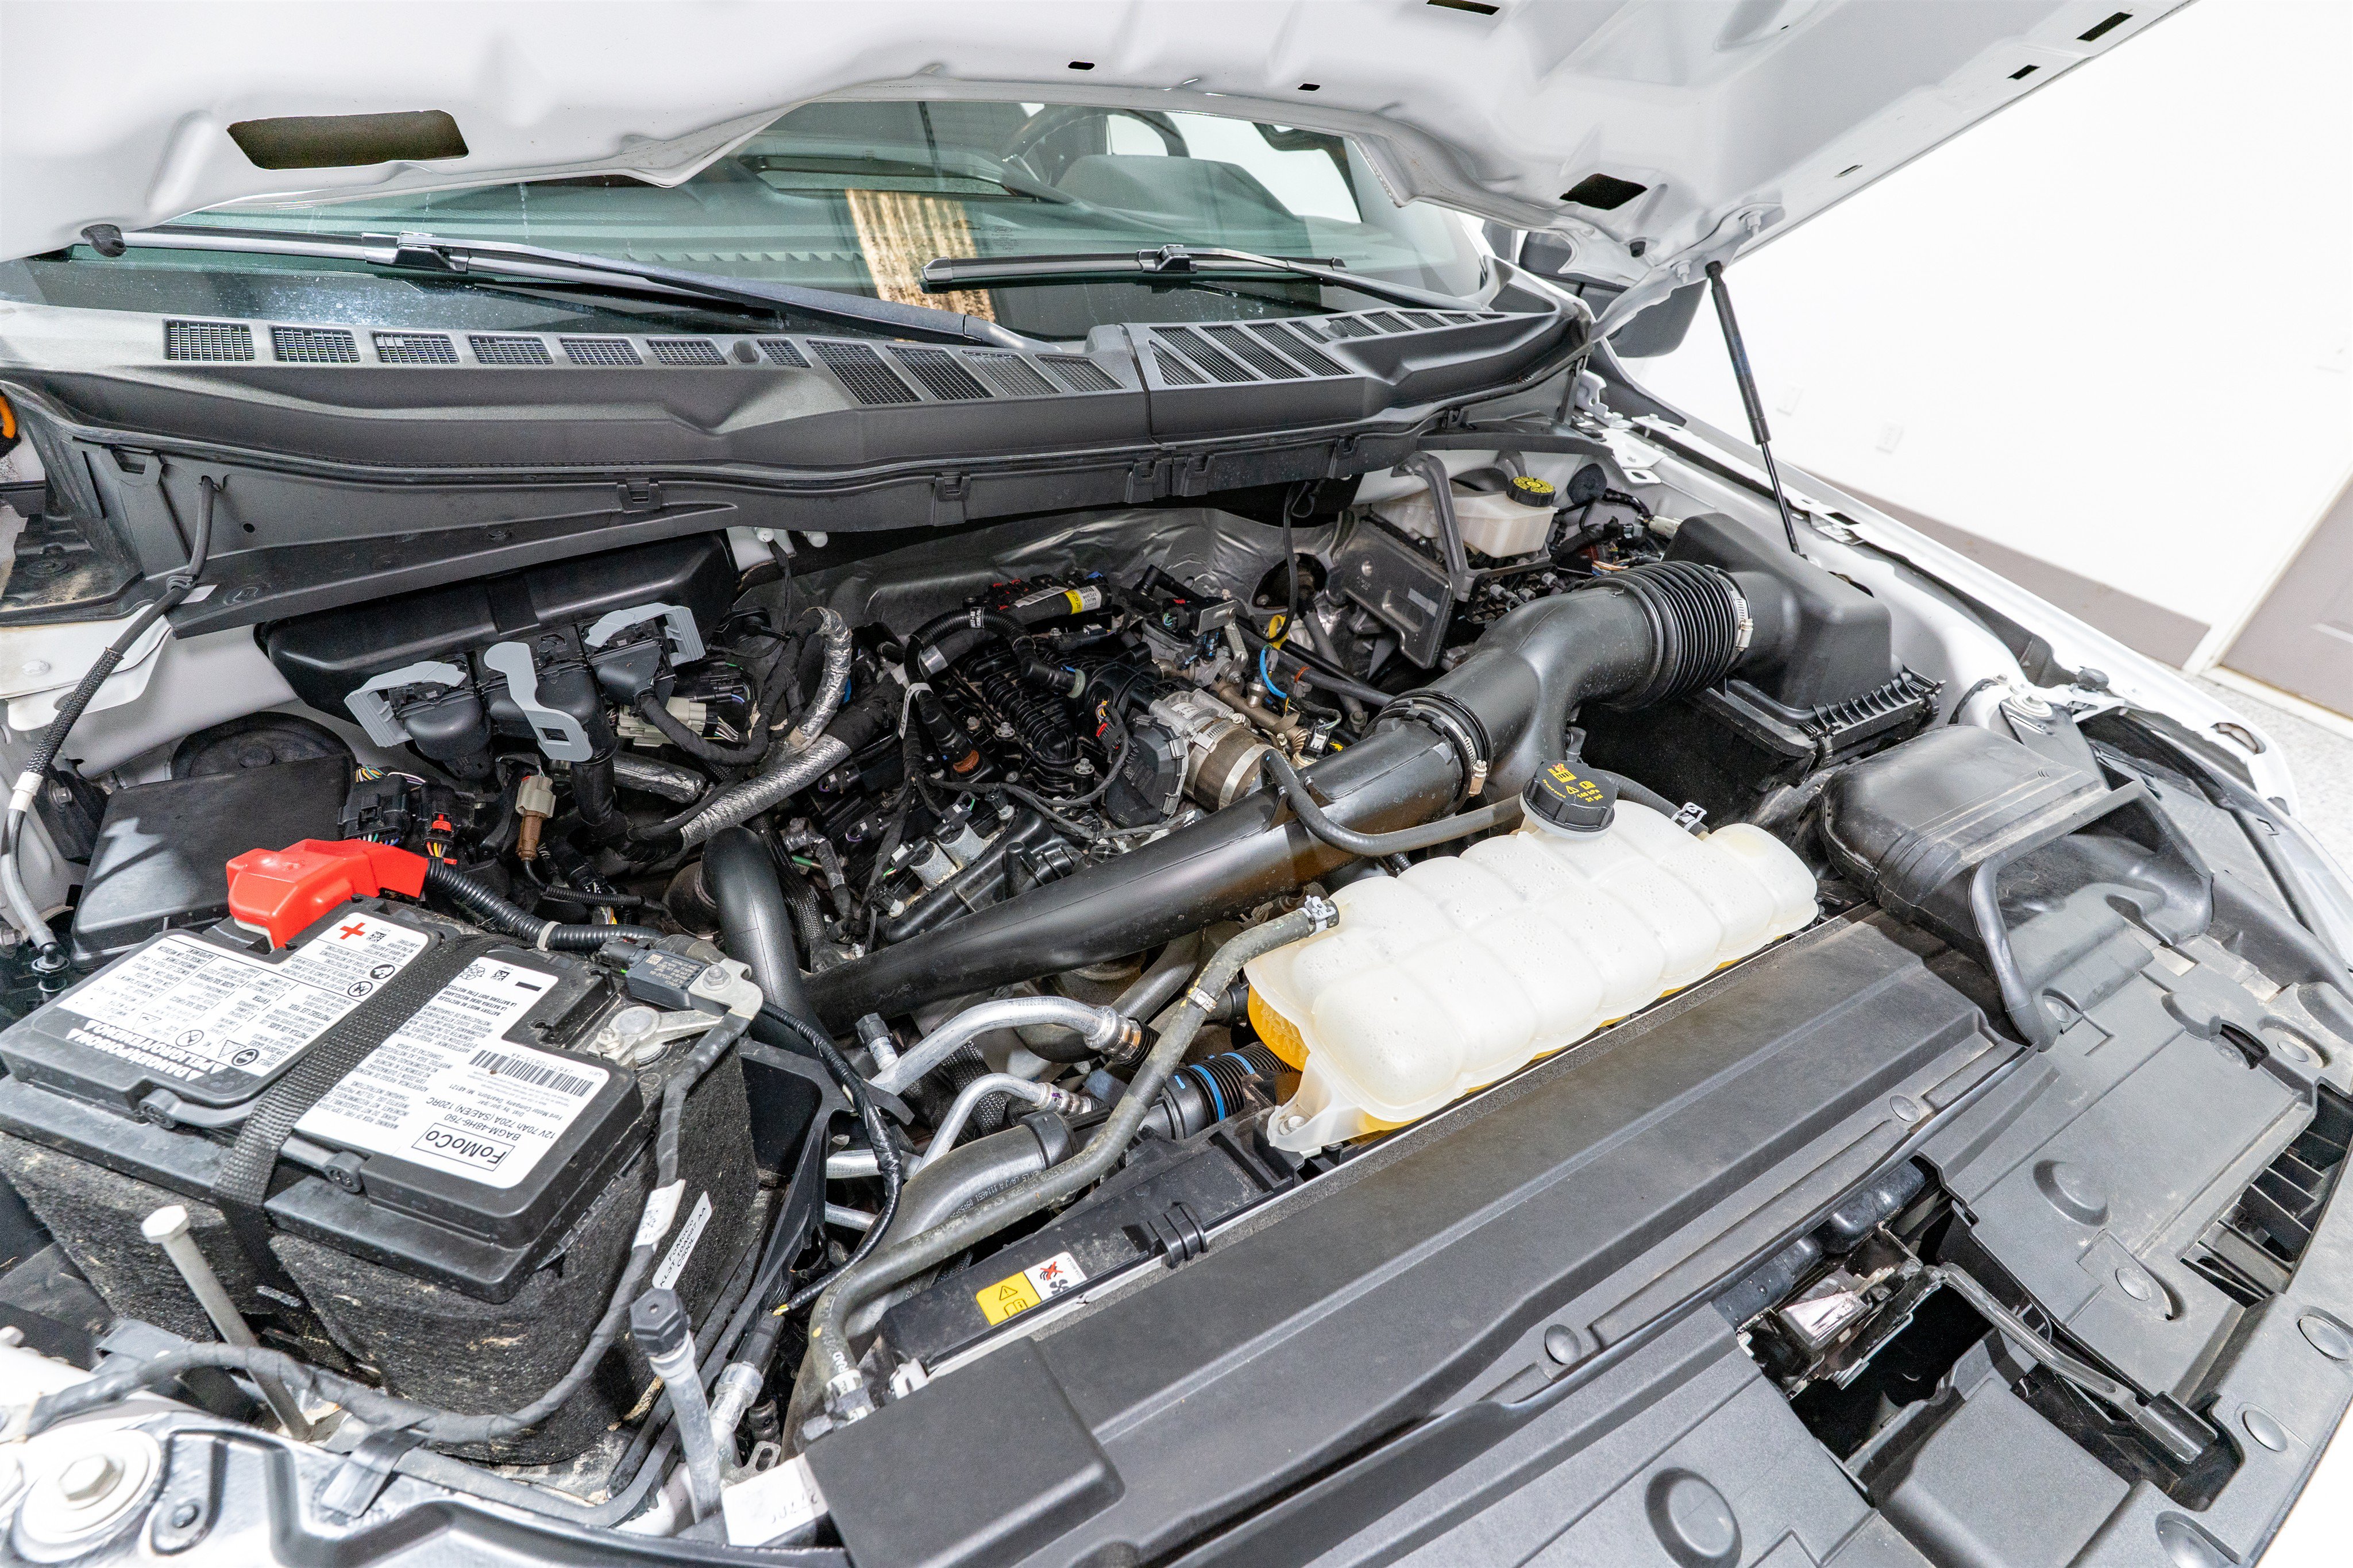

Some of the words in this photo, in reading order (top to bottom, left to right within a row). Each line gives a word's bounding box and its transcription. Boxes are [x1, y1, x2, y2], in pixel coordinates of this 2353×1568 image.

[437, 995, 461, 1005] RECYCLED
[442, 990, 470, 1001] RECICLARSE
[488, 996, 511, 1005] BATTERIE
[480, 1007, 501, 1016] BATTERY
[90, 1022, 217, 1071] PELIGRO/VENENO
[72, 1031, 194, 1078] DANGER/POISON
[448, 1083, 466, 1092] 48121
[425, 1096, 454, 1110] 120RC
[454, 1103, 496, 1121] (SAE/EN)
[531, 1107, 550, 1116] Motor
[443, 1113, 522, 1141] BAGM-48H6-760
[492, 1116, 516, 1127] 720A
[515, 1122, 539, 1134] 70Ah
[538, 1129, 557, 1139] 12V
[421, 1130, 507, 1164] FoMoCo
[974, 1184, 998, 1202] 1114651
[667, 1219, 695, 1261] FoMoCo
[675, 1236, 696, 1267] C500L
